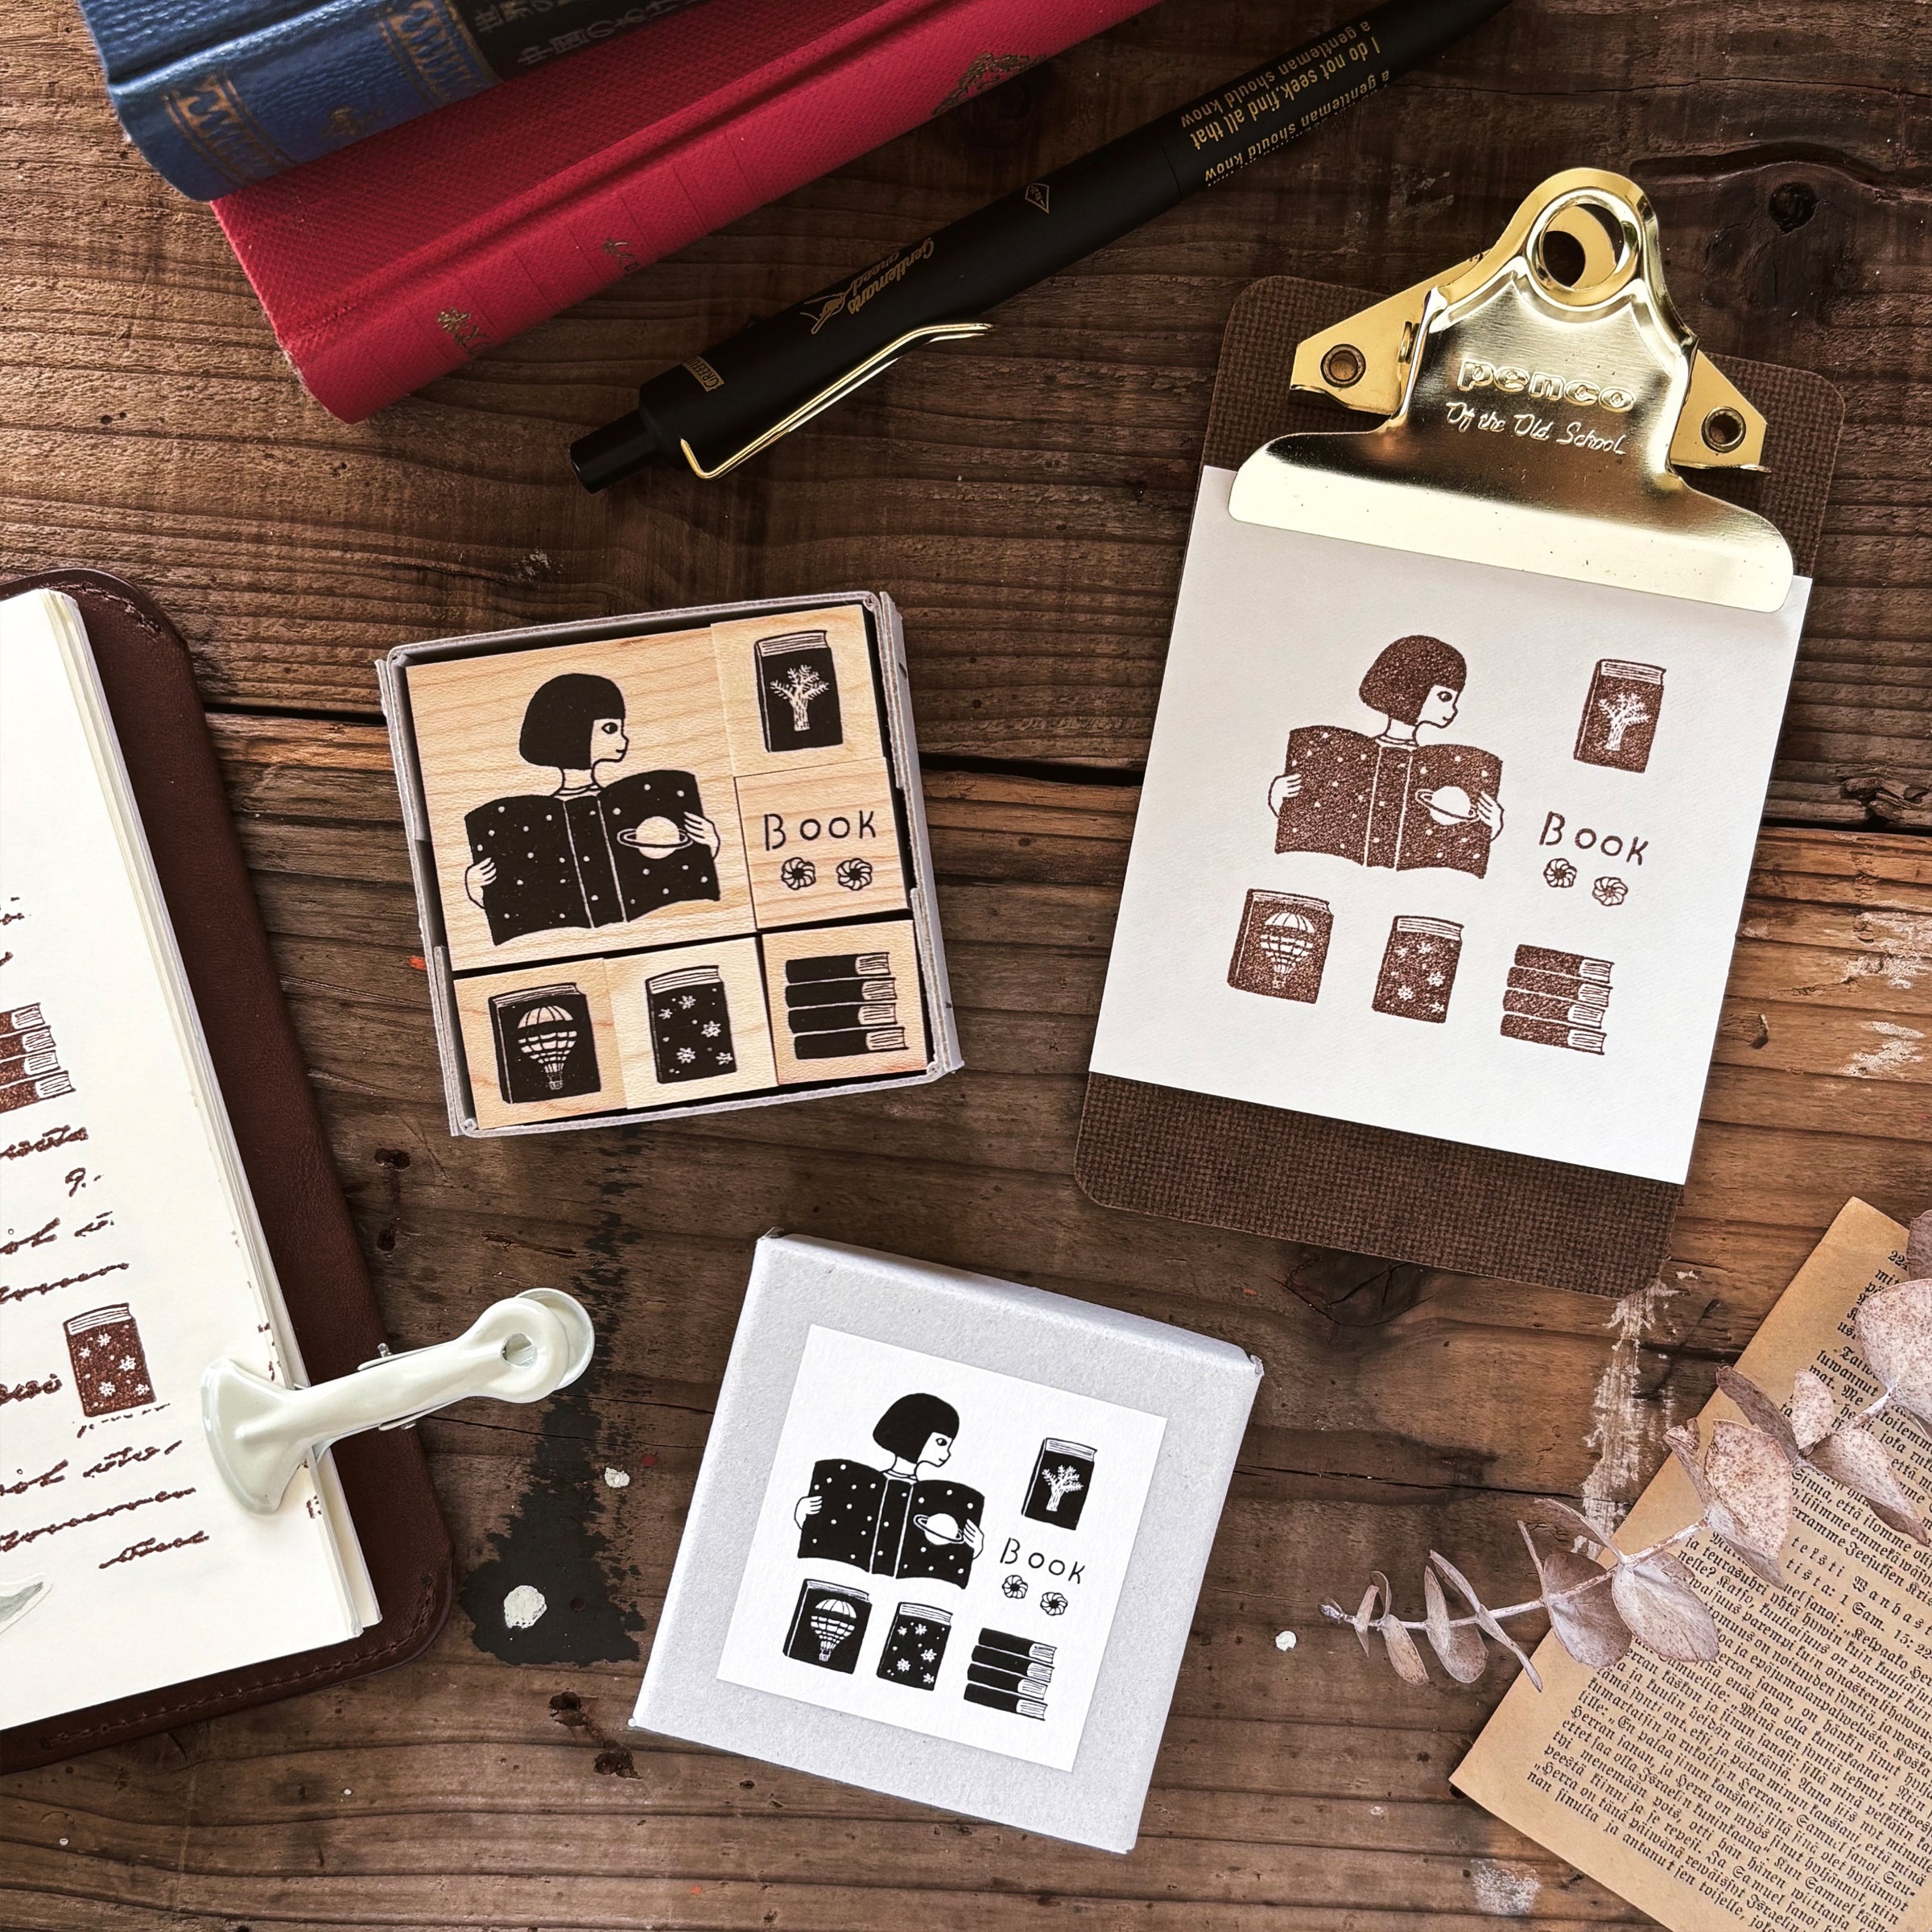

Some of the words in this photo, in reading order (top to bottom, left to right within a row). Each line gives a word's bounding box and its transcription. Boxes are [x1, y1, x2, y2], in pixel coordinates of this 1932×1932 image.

[1278, 26, 1357, 76] gentleman
[1348, 42, 1368, 62] do
[1360, 21, 1371, 32] a
[1224, 71, 1276, 109] should
[1301, 74, 1377, 126] gentleman
[1319, 54, 1346, 80] not
[1180, 97, 1224, 128] know
[1189, 121, 1224, 151] that
[1223, 108, 1246, 134] all
[1248, 123, 1296, 159] should
[1205, 152, 1243, 182] know
[1456, 359, 1637, 414] penco
[1445, 401, 1476, 433] Of
[1476, 411, 1506, 433] the
[1513, 413, 1552, 442] Old
[1555, 421, 1628, 456] School
[1841, 1385, 1864, 1406] Me
[1879, 1430, 1906, 1454] joka
[1891, 1459, 1917, 1480] että
[1791, 1468, 1833, 1504] Sinua,
[1836, 1500, 1862, 1521] että
[1863, 1514, 1912, 1552] ilomme
[1686, 1538, 1700, 1550] ja
[1703, 1546, 1769, 1596] teurasuhri
[1770, 1592, 1802, 1617] yhtä
[1802, 1612, 1843, 1646] hywin
[1845, 1641, 1873, 1666] kuin
[1845, 1542, 1905, 1587] Jeesuksen
[1678, 1550, 1717, 1579] nelle?
[1716, 1576, 1755, 1609] Katso,
[1759, 1603, 1831, 1654] kuuliaisuus
[1831, 1653, 1848, 1668] on
[1849, 1664, 1903, 1703] parempi
[1904, 1699, 1932, 1722] kuin
[1804, 1595, 1844, 1628] sanoi:
[1840, 1595, 1849, 1606] 1
[1852, 1602, 1885, 1632] Sam.
[1894, 1629, 1913, 1649] 15:
[1742, 1612, 1797, 1651] parempi
[1796, 1645, 1823, 1670] kuin
[1825, 1667, 1879, 1707] oinasten
[1754, 1639, 1771, 1655] on
[1772, 1650, 1835, 1697] noituuden
[1835, 1690, 1876, 1727] syntiä,
[1878, 1719, 1893, 1735] ja
[1726, 1678, 1757, 1701] enää
[1759, 1696, 1780, 1717] saa
[1784, 1715, 1808, 1736] olla
[1896, 1786, 1926, 1812] Niin
[1733, 1642, 1748, 1658] ja
[1750, 1655, 1889, 1753] epäjumalanpalwelusta.
[1893, 1748, 1931, 1778] Koska
[1756, 1676, 1794, 1711] sanan,
[1802, 1708, 1818, 1724] on
[1823, 1719, 1864, 1753] hänkin
[1867, 1749, 1901, 1777] sinut
[1587, 1678, 1662, 1733] kumartaisin
[1663, 1727, 1677, 1743] ja
[1797, 1814, 1847, 1852] Samuel
[1846, 1847, 1879, 1875] sanoi
[1629, 1667, 1643, 1683] ja
[1646, 1678, 1686, 1711] kuulin
[1689, 1707, 1732, 1741] heidän
[1734, 1740, 1791, 1782] ääntänsä.
[1798, 1777, 1832, 1807] Anna
[1834, 1802, 1856, 1823] siis
[1860, 1821, 1884, 1840] nyt
[1886, 1838, 1932, 1873] minulle
[1629, 1686, 1662, 1712] synti
[1715, 1743, 1729, 1758] ja
[1730, 1754, 1766, 1783] palaa
[1767, 1778, 1809, 1810] minun
[1810, 1804, 1861, 1848] kanssani,
[1865, 1844, 1890, 1864] että
[1892, 1860, 1927, 1887] minä
[1662, 1670, 1703, 1703] käskyn
[1703, 1698, 1719, 1714] ja
[1719, 1708, 1755, 1738] sinun
[1758, 1732, 1799, 1767] sanasi:
[1799, 1761, 1827, 1785] sillä
[1830, 1782, 1862, 1809] minä
[1865, 1805, 1914, 1842] pelkäsin
[1775, 1728, 1802, 1750] olen
[1802, 1743, 1841, 1776] syntiä
[1843, 1772, 1885, 1807] tehnyt,
[1544, 1744, 1587, 1777] peestä
[1590, 1773, 1627, 1803] kiinni
[1630, 1799, 1644, 1814] ja
[1646, 1810, 1661, 1824] se
[1664, 1823, 1702, 1854] repesi.
[1732, 1866, 1785, 1905] Samuel
[1785, 1901, 1818, 1929] sanoi
[1563, 1720, 1592, 1743] ettet
[1591, 1736, 1612, 1757] saa
[1613, 1753, 1637, 1773] olla
[1639, 1768, 1692, 1809] Israelin
[1774, 1857, 1802, 1880] Kun
[1805, 1876, 1856, 1914] Samuel
[1571, 1705, 1616, 1740] Herran
[1617, 1734, 1655, 1769] sanan,
[1659, 1762, 1674, 1778] ja
[1675, 1774, 1712, 1804] Herra
[1715, 1801, 1732, 1816] on
[1734, 1813, 1770, 1839] myös
[1769, 1835, 1804, 1863] sinut
[1805, 1857, 1866, 1907] hyljännyt,
[1871, 1902, 1899, 1926] niin
[1579, 1690, 1608, 1716] lille:
[1637, 1731, 1674, 1759] palaa
[1674, 1756, 1709, 1781] sinun
[1765, 1812, 1791, 1836] sillä
[1792, 1831, 1816, 1855] sinä
[1821, 1852, 1846, 1871] olet
[1847, 1866, 1909, 1912] hyljännyt
[1580, 1750, 1647, 1798] menemään
[1653, 1796, 1682, 1823] pois,
[1689, 1822, 1712, 1841] otti
[1718, 1838, 1742, 1860] hän
[1748, 1856, 1786, 1889] hänen
[1791, 1888, 1850, 1930] wiittansa
[1527, 1772, 1552, 1793] nan
[1554, 1788, 1599, 1823] sinulta
[1605, 1823, 1619, 1835] ja
[1623, 1834, 1675, 1871] antanut
[1674, 1865, 1696, 1885] sen
[1699, 1881, 1744, 1920] toiselle,
[1580, 1788, 1596, 1802] on
[1599, 1798, 1627, 1823] tänä
[1629, 1818, 1686, 1860] päiwänä
[1685, 1856, 1745, 1898] rewäissyt
[1747, 1894, 1799, 1932] Israelin
